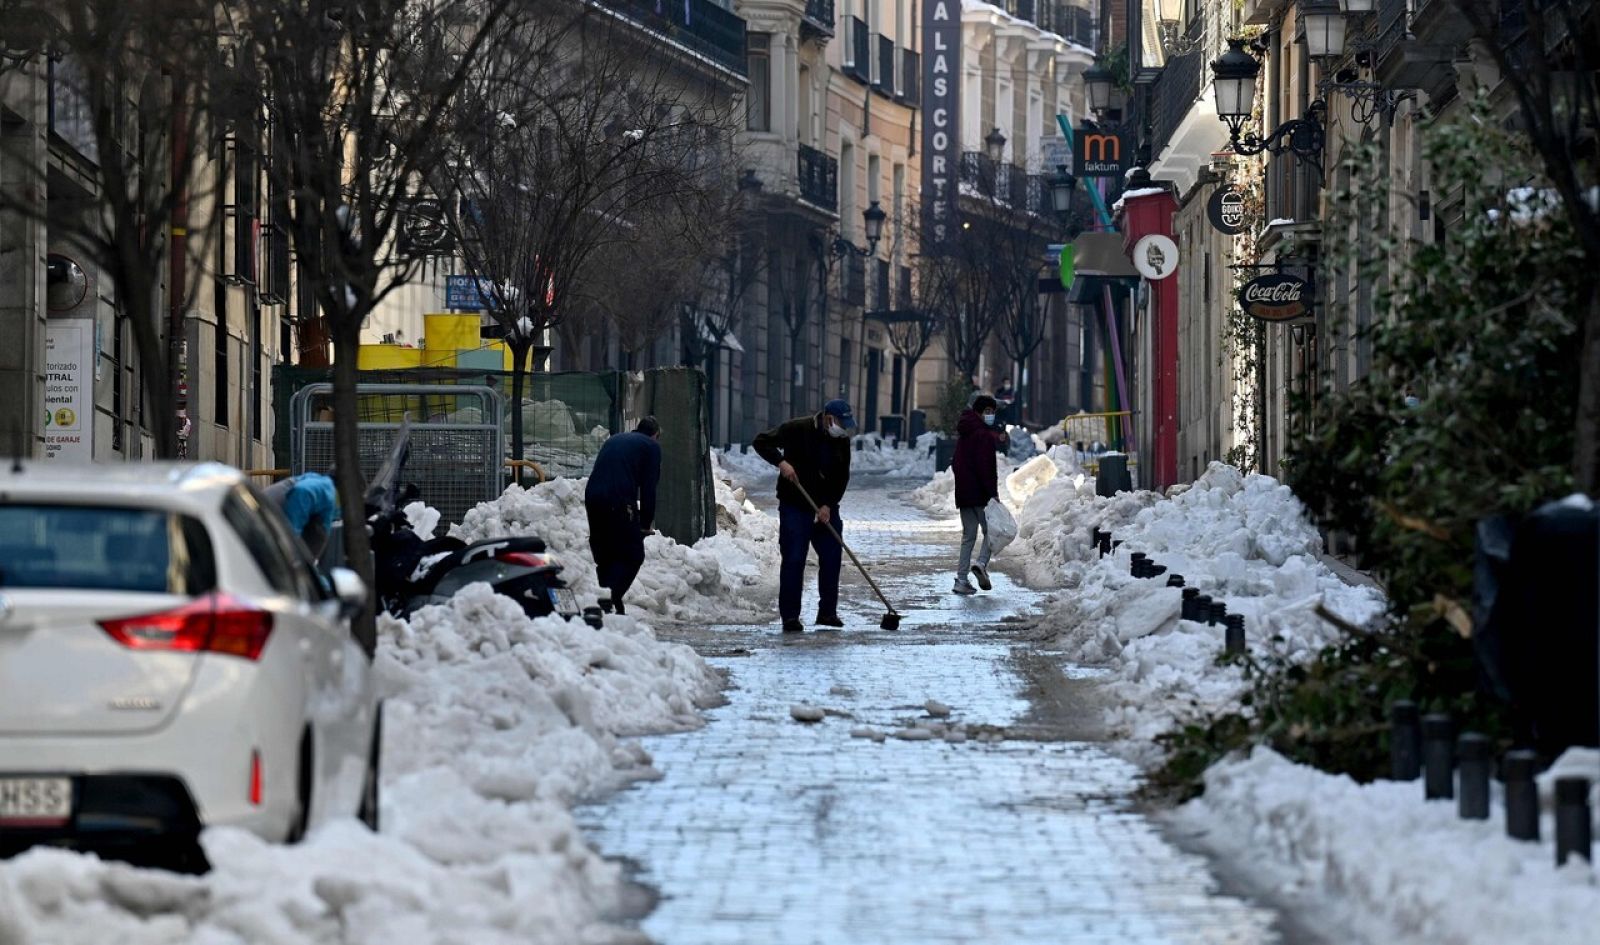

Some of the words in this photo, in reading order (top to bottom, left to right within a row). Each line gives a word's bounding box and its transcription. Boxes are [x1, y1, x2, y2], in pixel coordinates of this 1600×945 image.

[933, 31, 949, 97] LAS
[1084, 134, 1120, 161] m
[1084, 162, 1120, 171] faktum
[932, 108, 948, 243] CORTES
